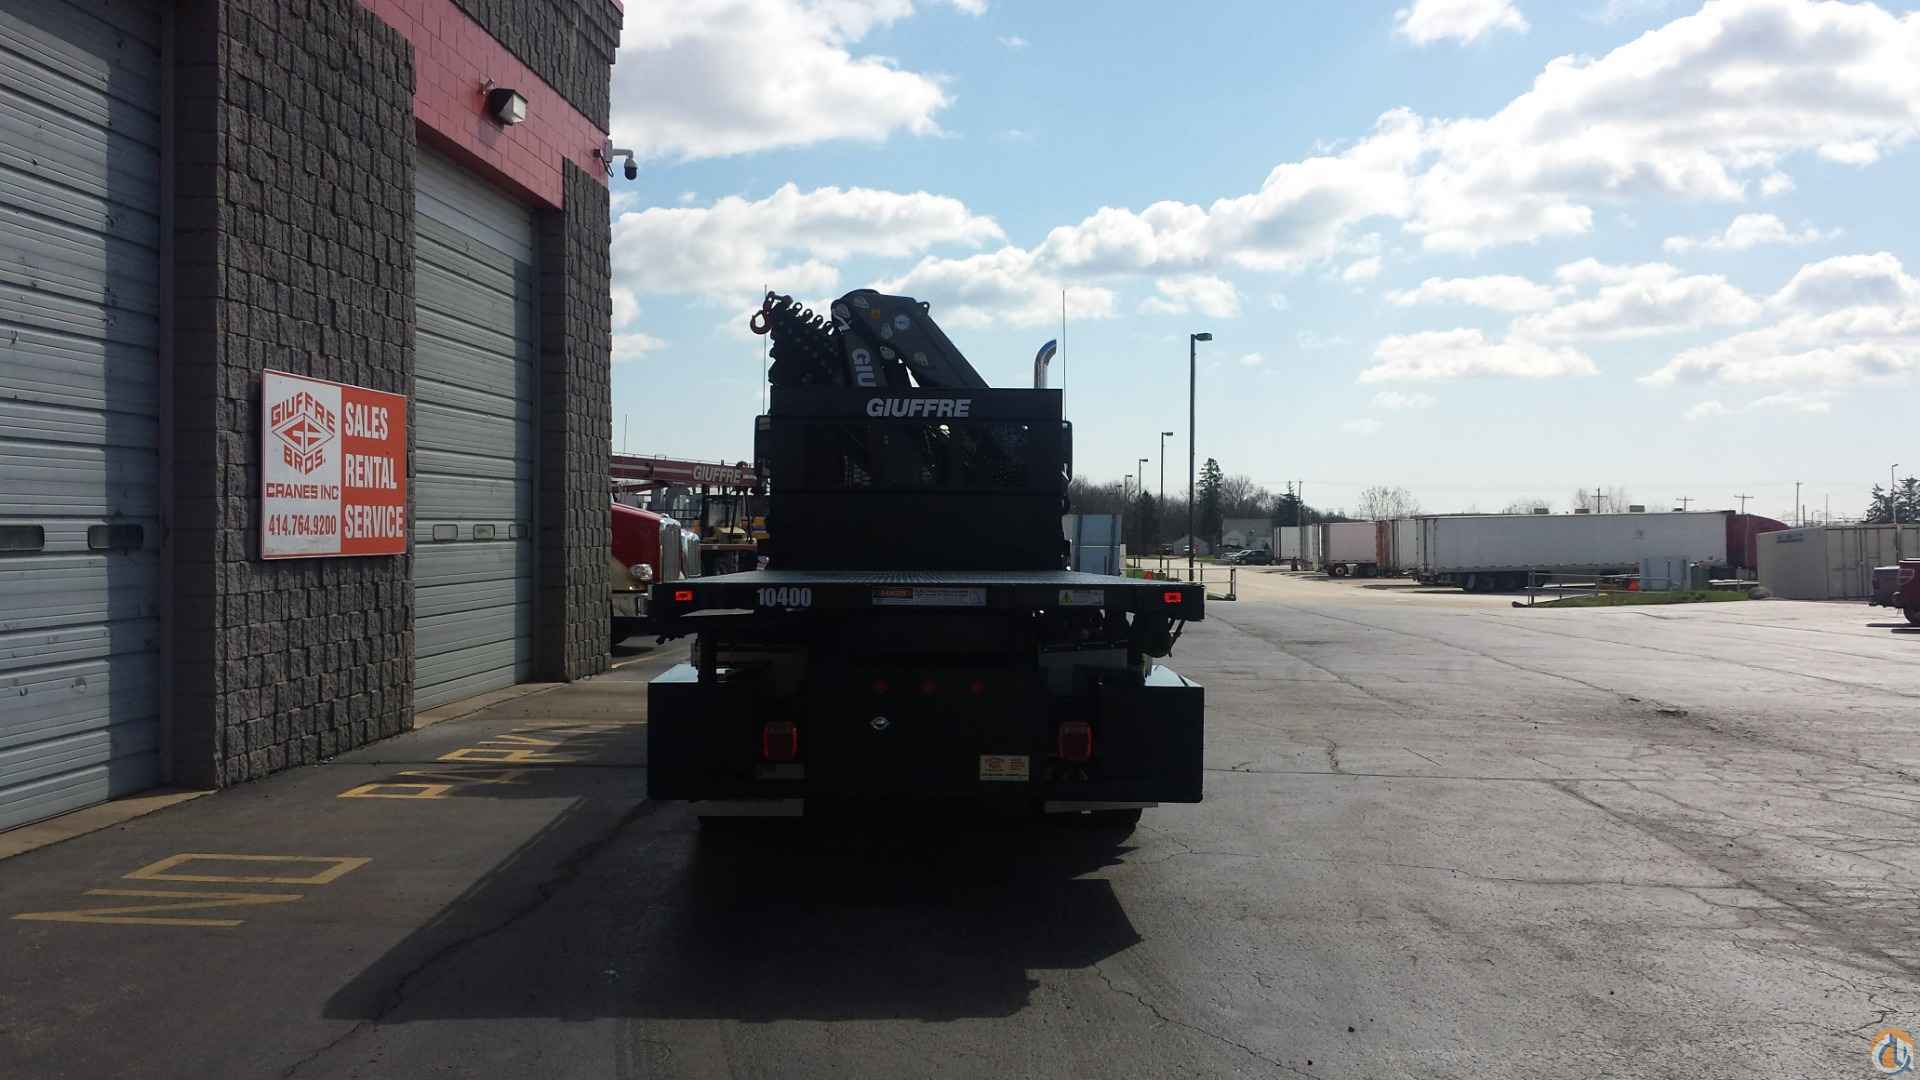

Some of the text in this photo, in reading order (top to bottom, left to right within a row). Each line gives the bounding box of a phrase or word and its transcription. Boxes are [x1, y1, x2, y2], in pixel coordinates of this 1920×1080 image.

[271, 392, 335, 433] GIUFFRE
[866, 398, 972, 418] GIUFFRE
[345, 402, 388, 440] SALES
[284, 445, 326, 475] BROS.
[345, 454, 397, 489] RENTAL
[692, 465, 742, 483] GIUFFRE
[266, 483, 339, 500] CRANES INC
[268, 515, 337, 536] 414.764.9200
[344, 505, 404, 538] SERVICE
[756, 587, 812, 607] 10400
